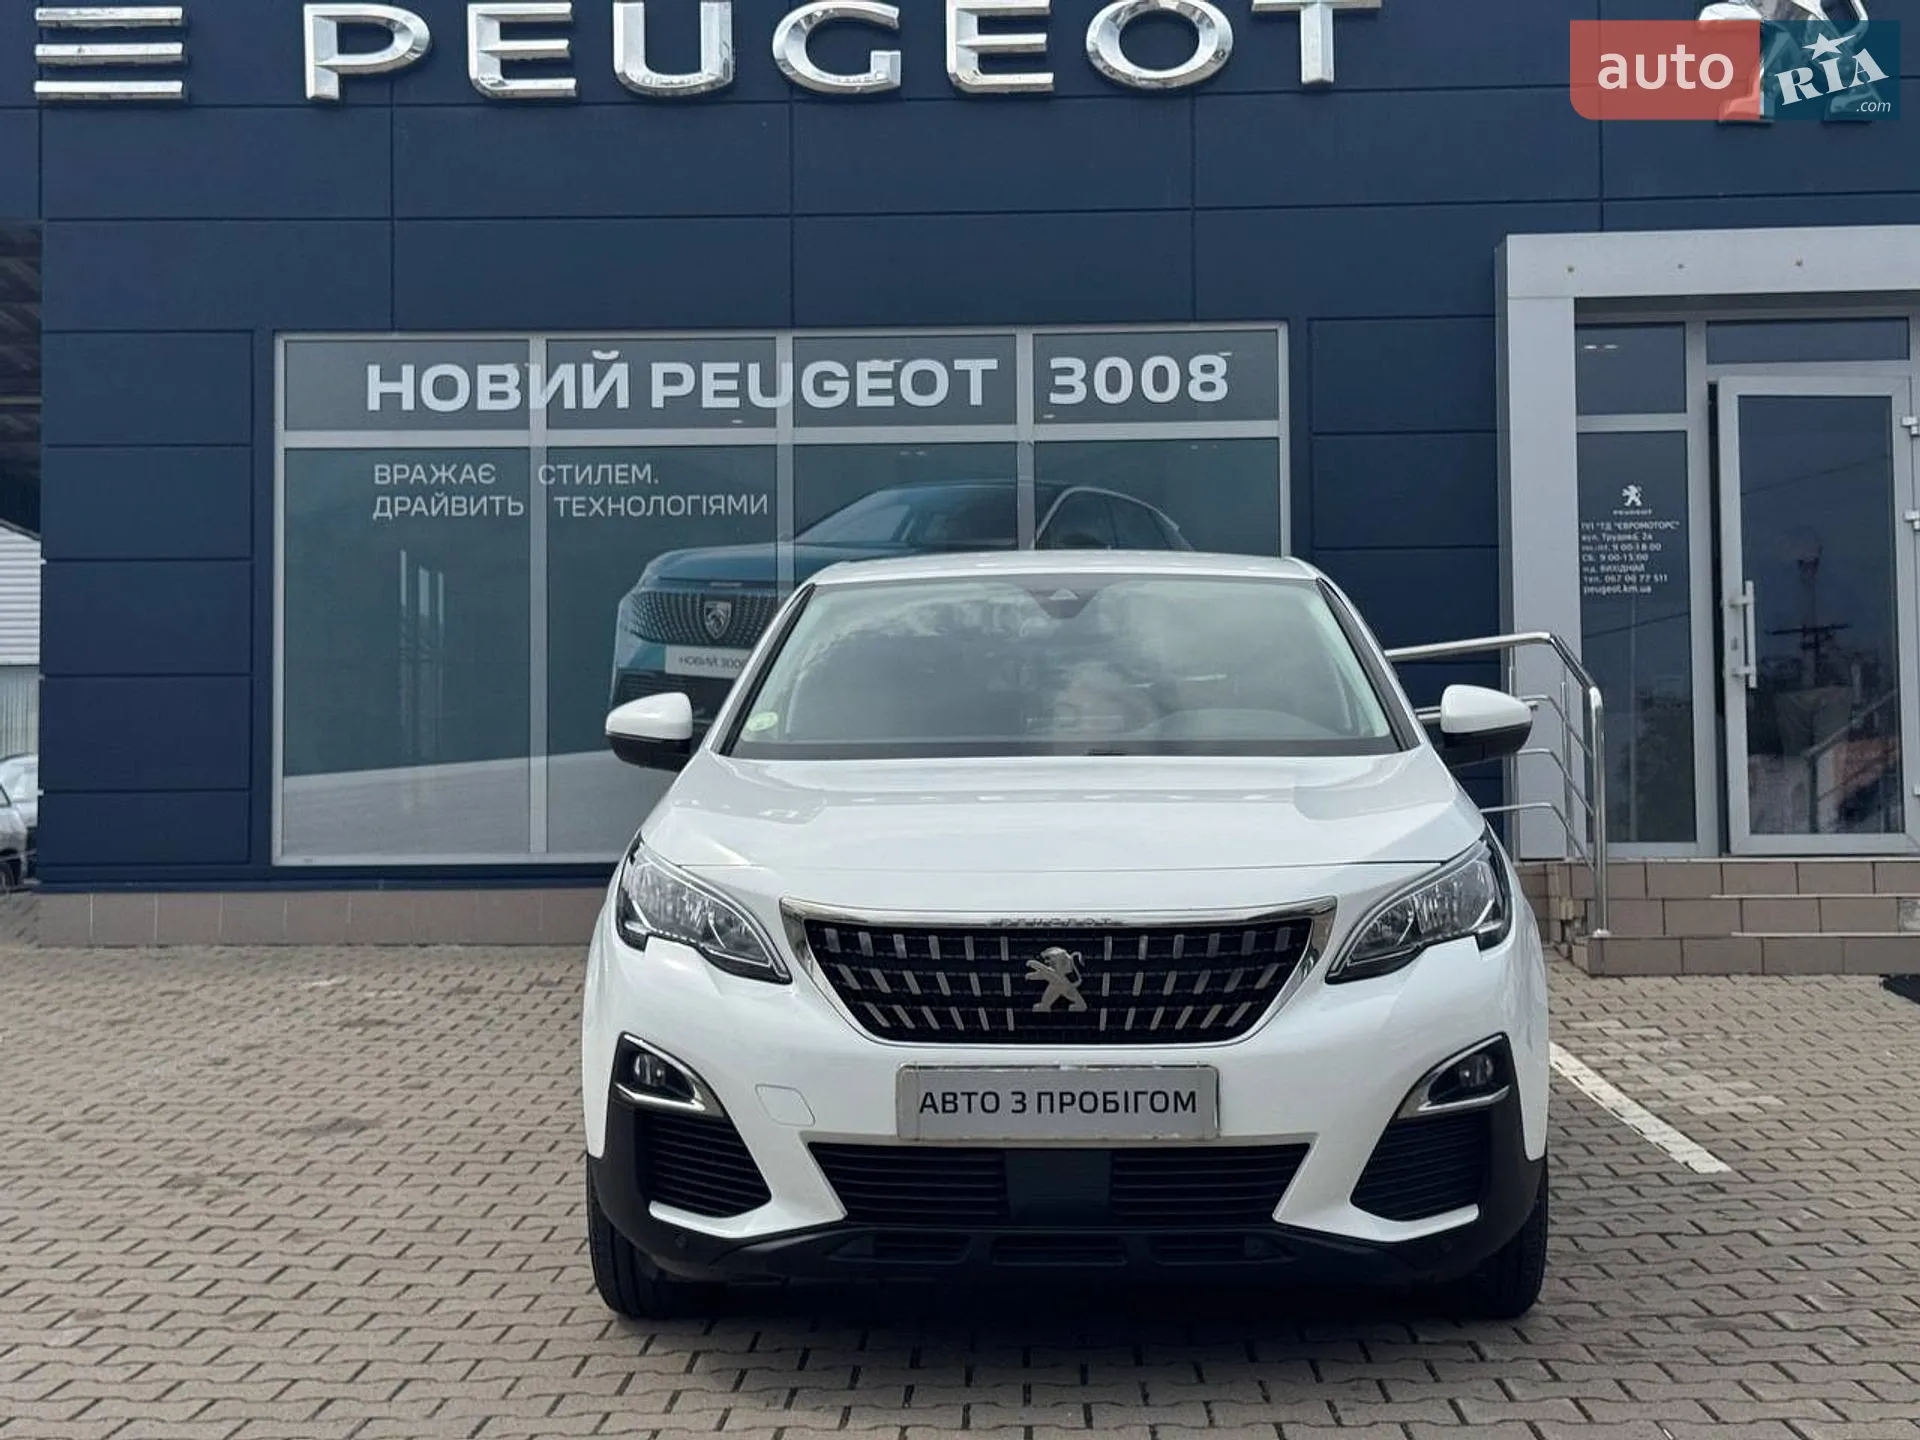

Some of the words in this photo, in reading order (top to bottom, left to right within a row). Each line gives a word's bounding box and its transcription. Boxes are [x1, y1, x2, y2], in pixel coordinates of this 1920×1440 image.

[303, 0, 1382, 102] PEUGEOT
[366, 350, 630, 413] НОВИЙ
[650, 357, 999, 409] PEUGEOT
[1048, 354, 1229, 405] 3008
[373, 463, 497, 486] ВРАЖАЄ
[537, 463, 659, 485] СТИЛЕМ.
[372, 493, 525, 521] ДРАЙВИТЬ
[554, 493, 770, 518] ТЕХНОЛОГІЯМИ
[919, 1091, 1000, 1114] АВТО
[1037, 1090, 1197, 1114] ПРОБІГОМ
